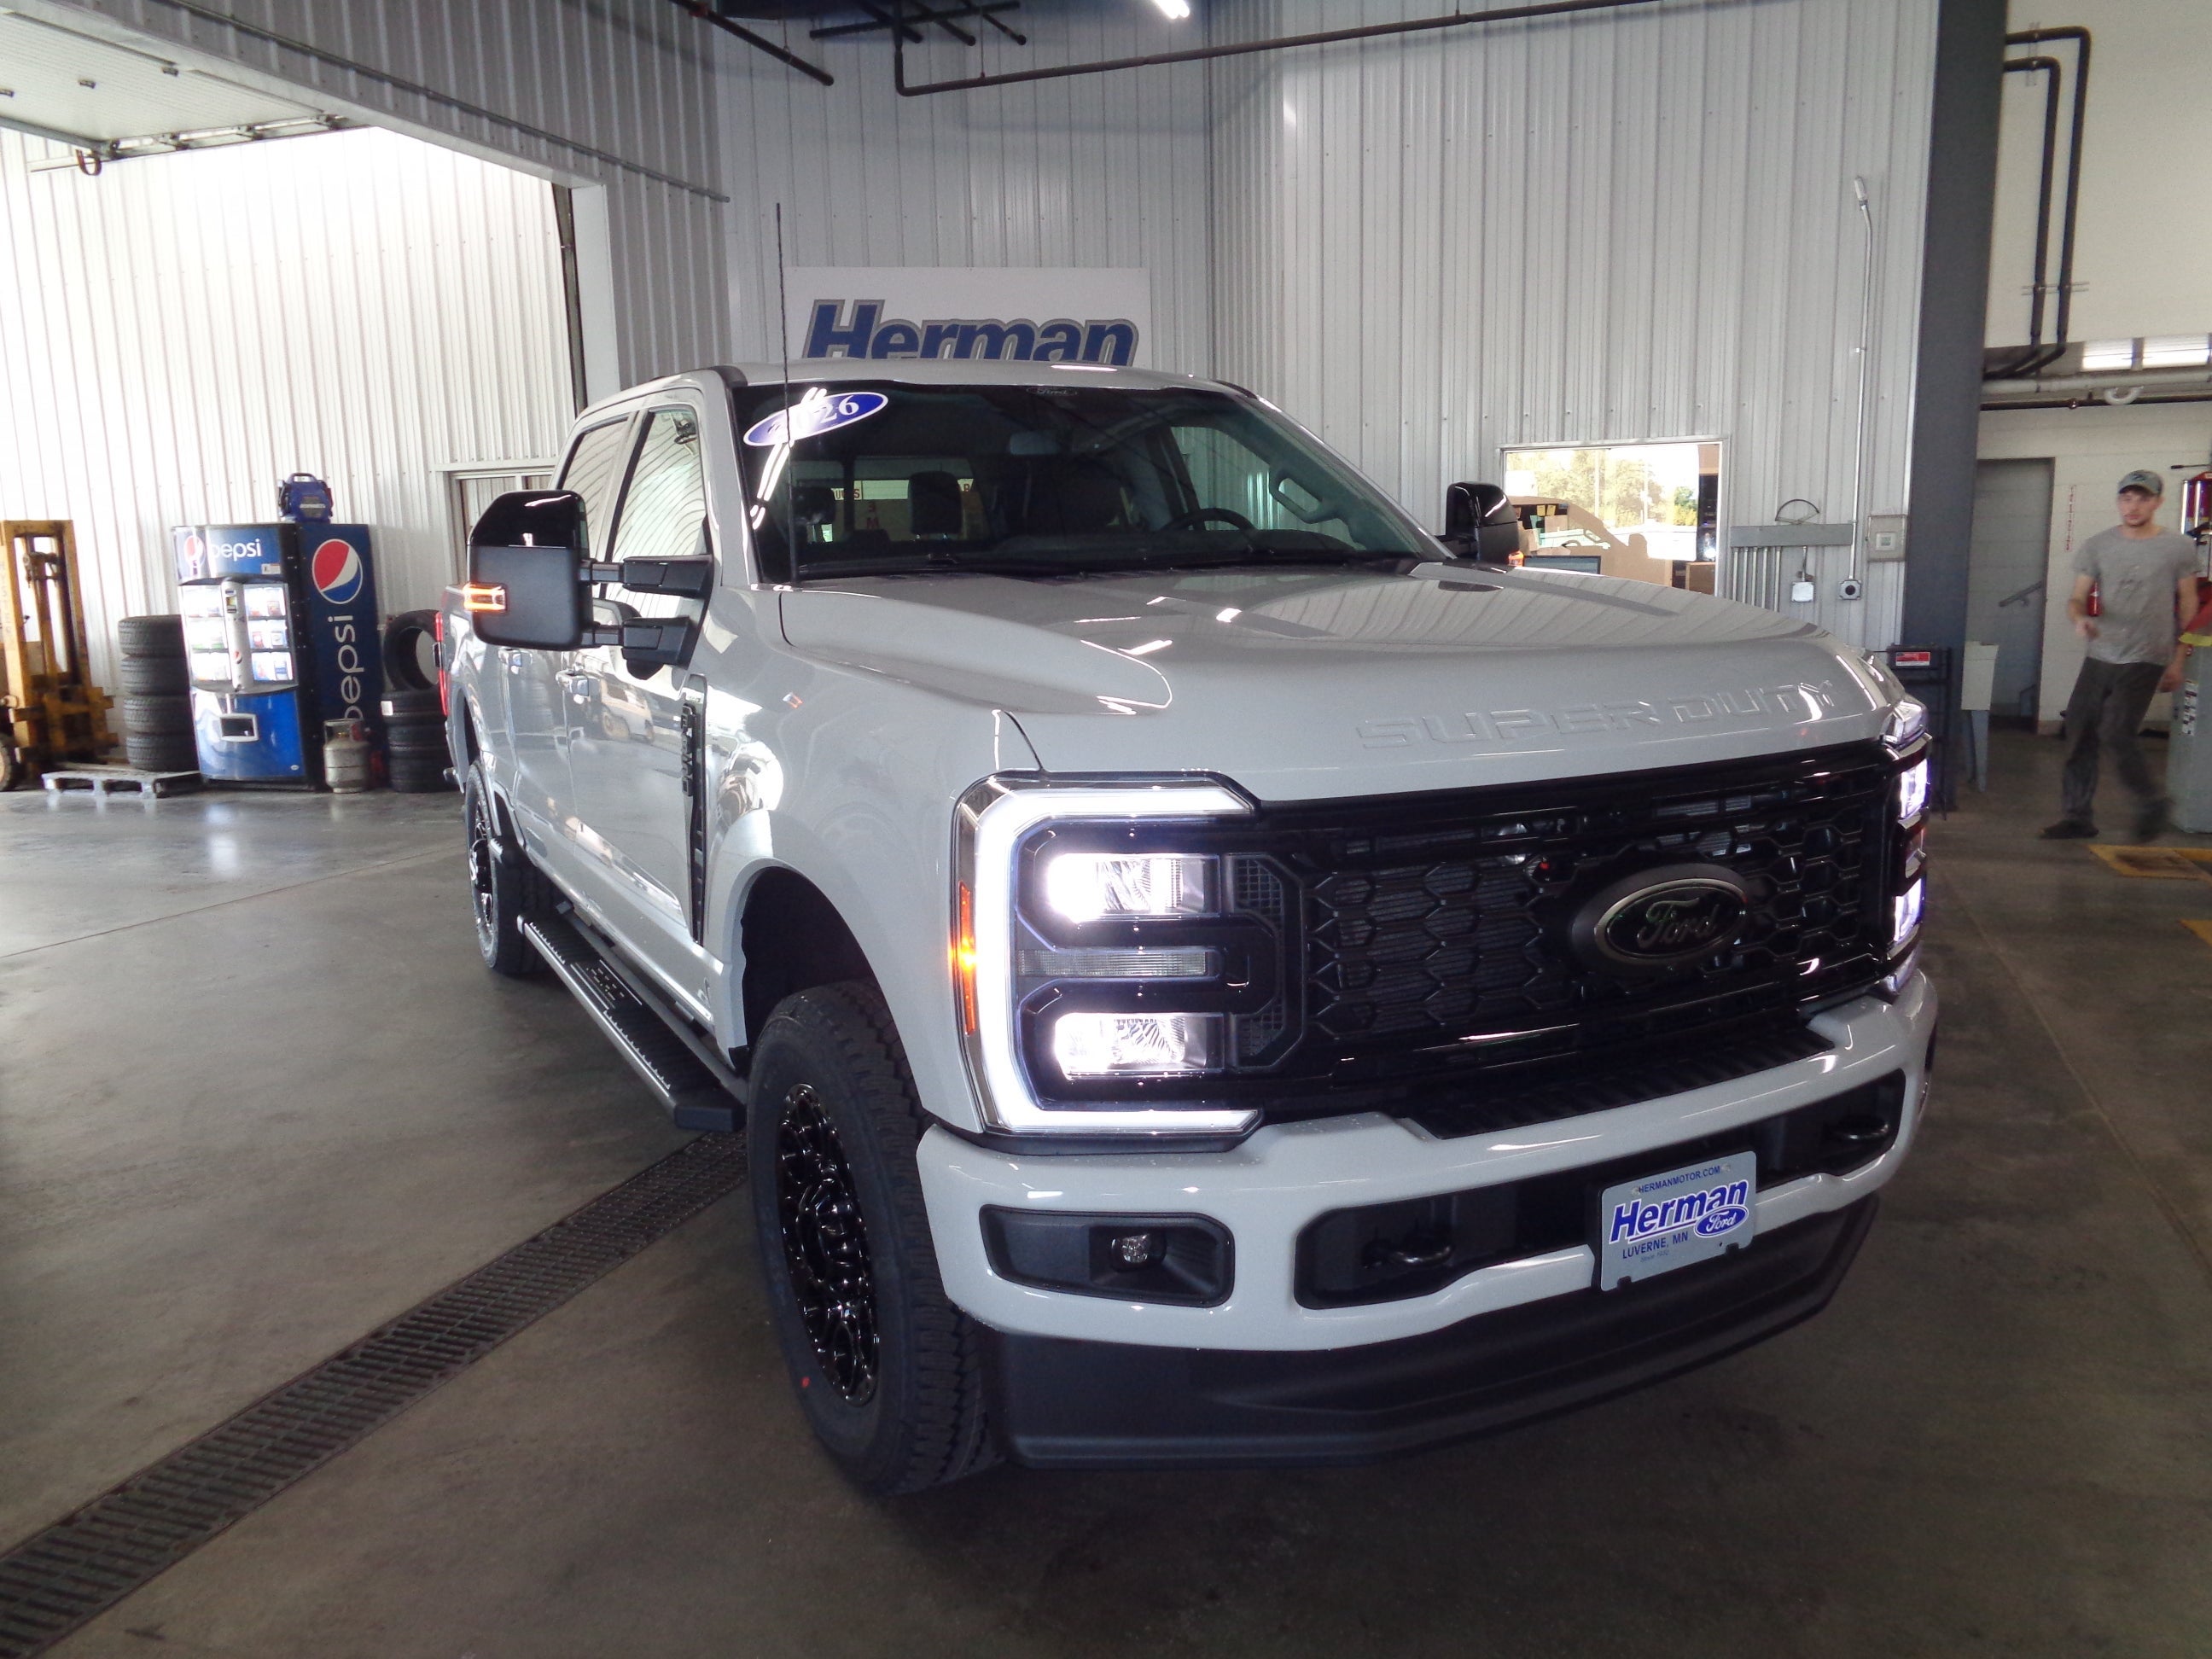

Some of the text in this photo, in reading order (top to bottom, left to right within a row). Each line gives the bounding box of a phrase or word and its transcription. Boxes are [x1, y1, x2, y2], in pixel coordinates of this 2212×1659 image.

[801, 300, 1138, 367] Herman
[211, 538, 262, 562] pepsi
[1356, 679, 1837, 749] SUPER DUTY
[1636, 897, 1721, 949] Ford
[1639, 1166, 1720, 1194] HERMANMOTOR.COM
[1609, 1179, 1749, 1244] Herman
[1706, 1210, 1738, 1232] Ford
[1622, 1237, 1669, 1260] LUVERNE,
[1672, 1231, 1689, 1245] MN
